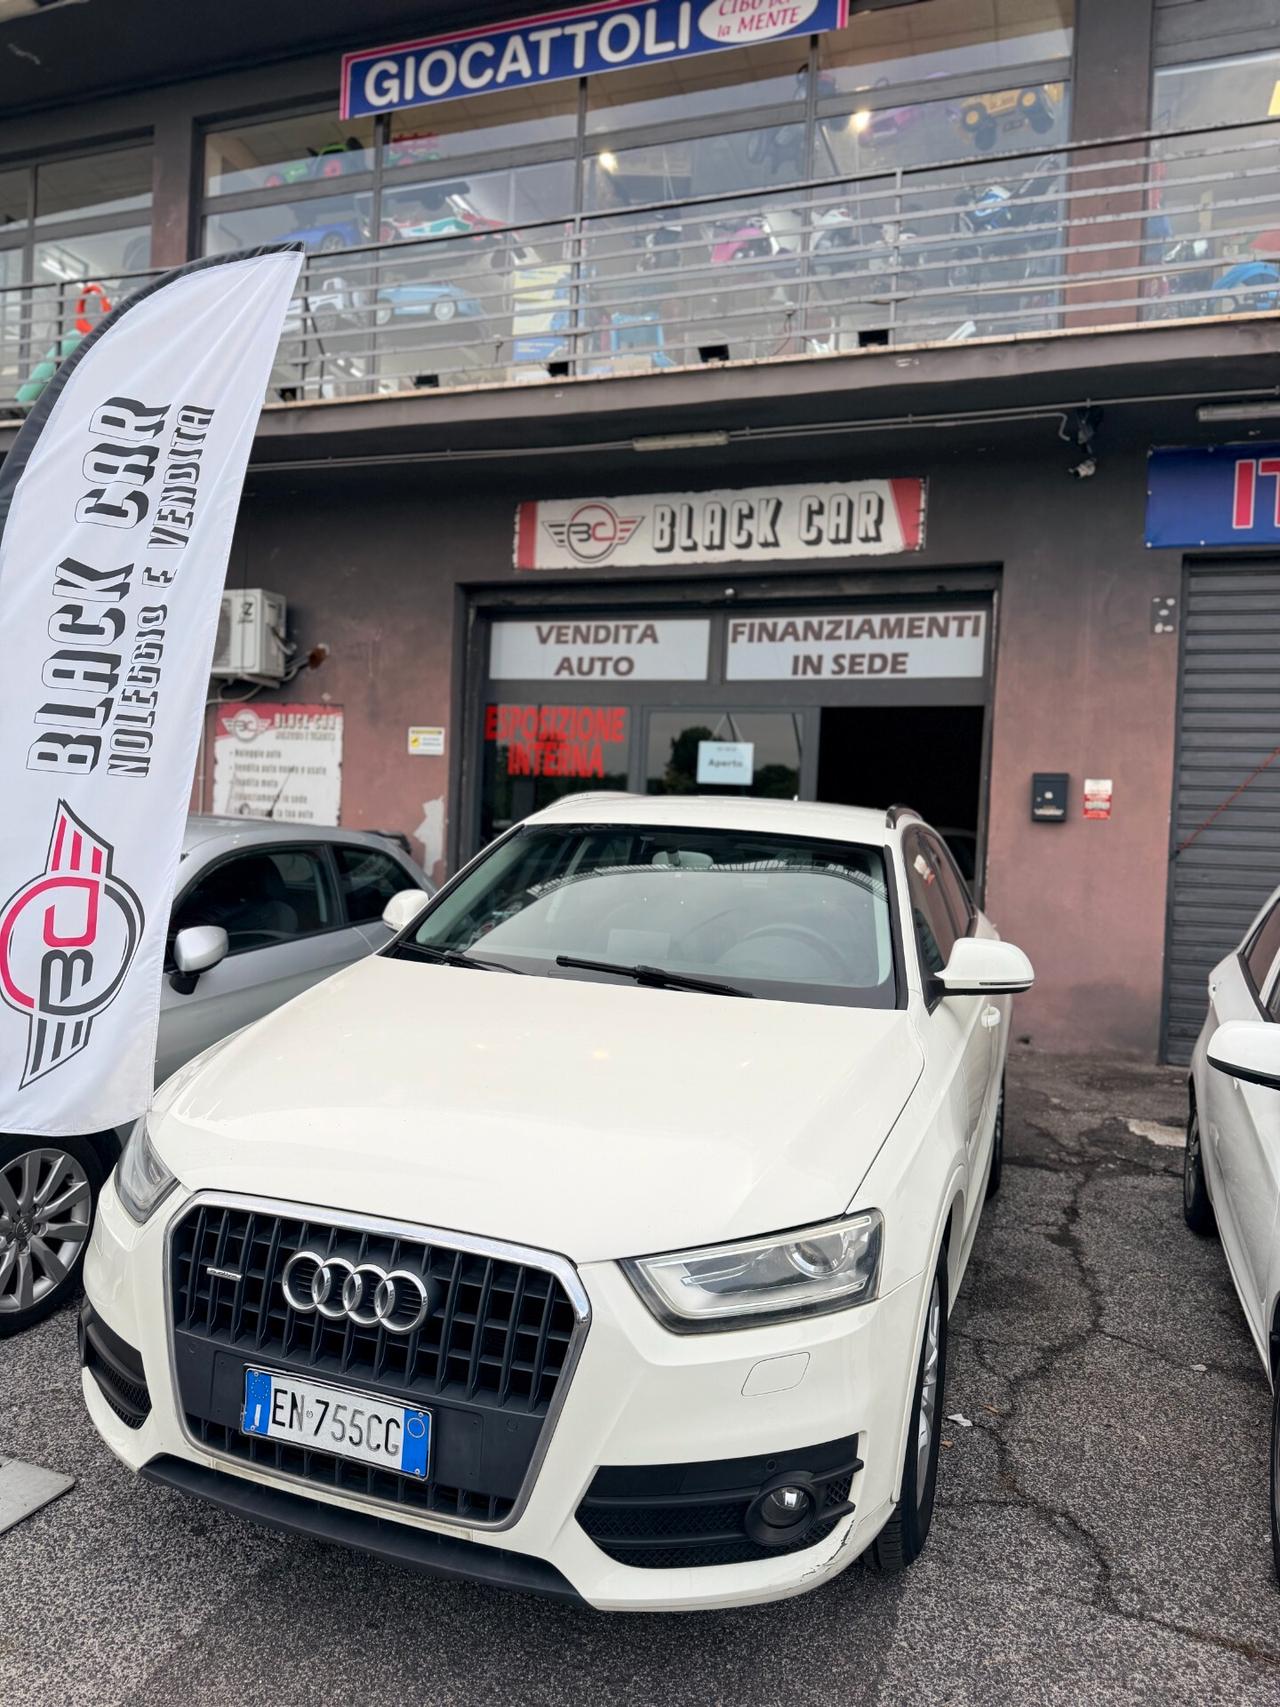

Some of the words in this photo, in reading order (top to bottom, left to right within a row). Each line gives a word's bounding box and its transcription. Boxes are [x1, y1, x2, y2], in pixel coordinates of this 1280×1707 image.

[718, 0, 763, 16] CIBO
[737, 6, 801, 34] MENTE
[364, 1, 691, 107] GIOCATTOLI
[75, 396, 172, 529] CAR
[147, 404, 215, 549] VENDITA
[653, 498, 782, 553] BLACK
[800, 491, 884, 546] CAR
[142, 566, 177, 588] E
[535, 623, 659, 645] VENDITA
[731, 615, 982, 643] FINANZIAMENTI
[26, 557, 134, 775] BLACK
[553, 656, 635, 677] AUTO
[791, 654, 823, 676] IN
[831, 652, 909, 675] SEDE
[107, 604, 167, 778] NOLEGGIO
[484, 705, 627, 743] ESPOSIZIONE
[507, 741, 604, 778] INTERNA
